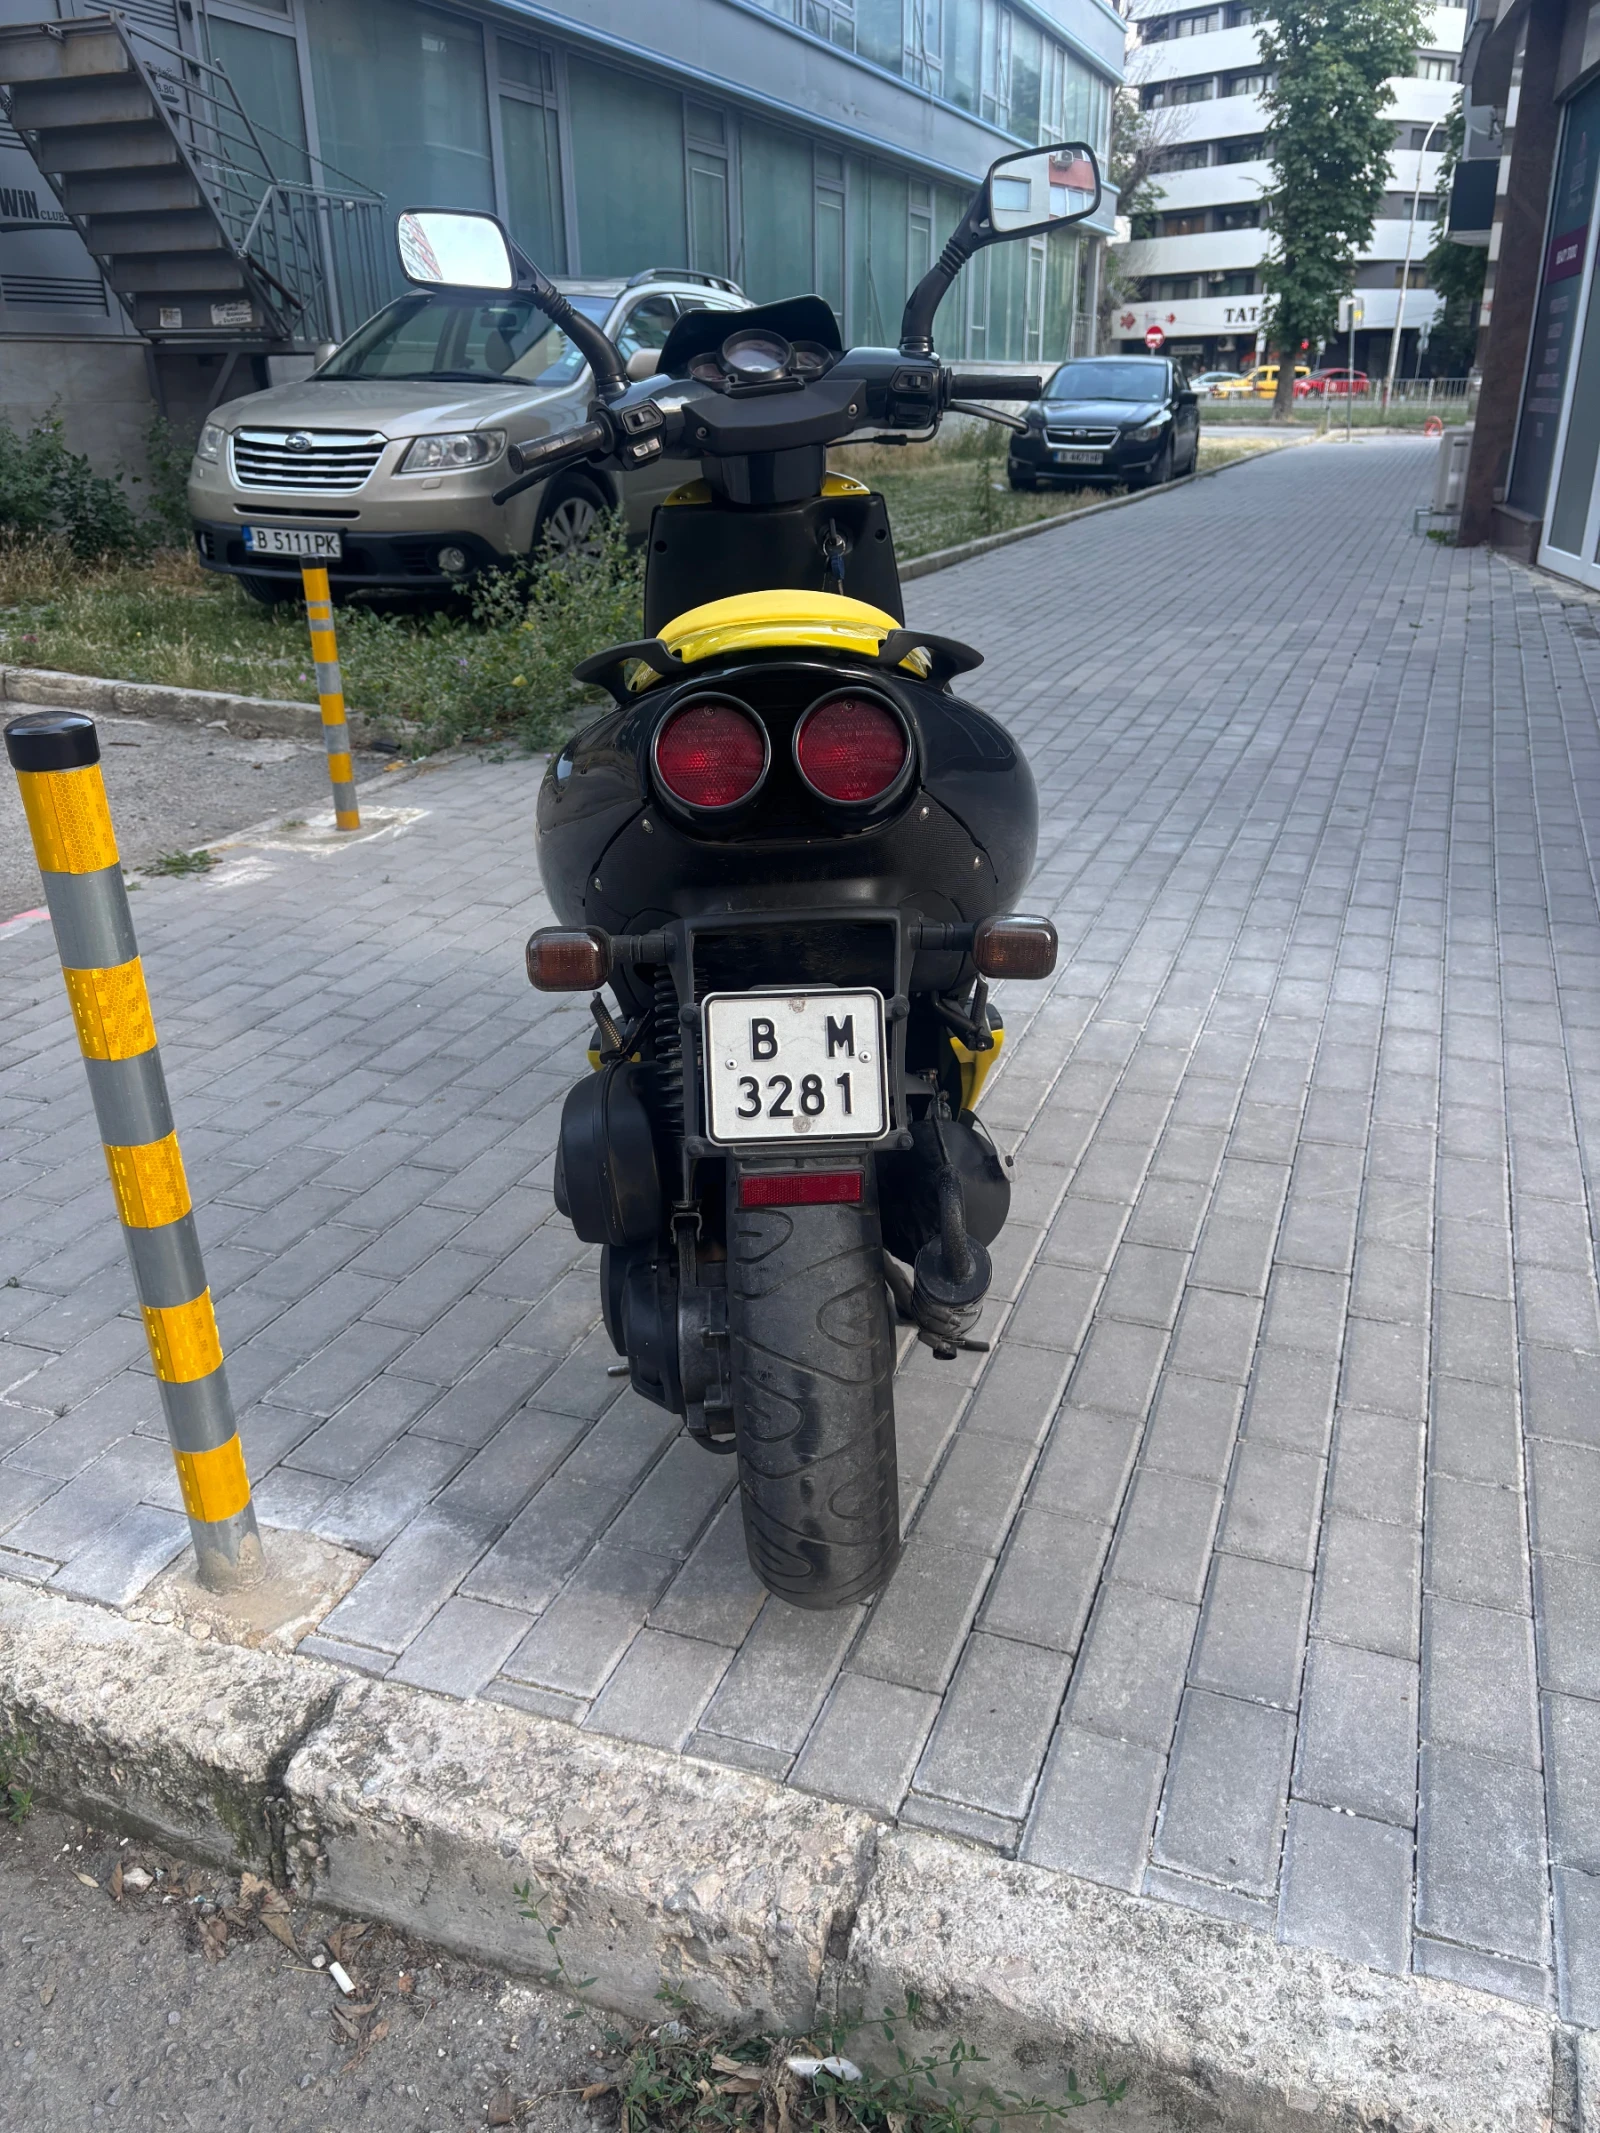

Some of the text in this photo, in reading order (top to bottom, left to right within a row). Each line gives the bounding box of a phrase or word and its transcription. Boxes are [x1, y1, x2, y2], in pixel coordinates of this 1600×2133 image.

[257, 530, 268, 549] B
[751, 1014, 855, 1060] B M
[737, 1072, 853, 1118] 3281
